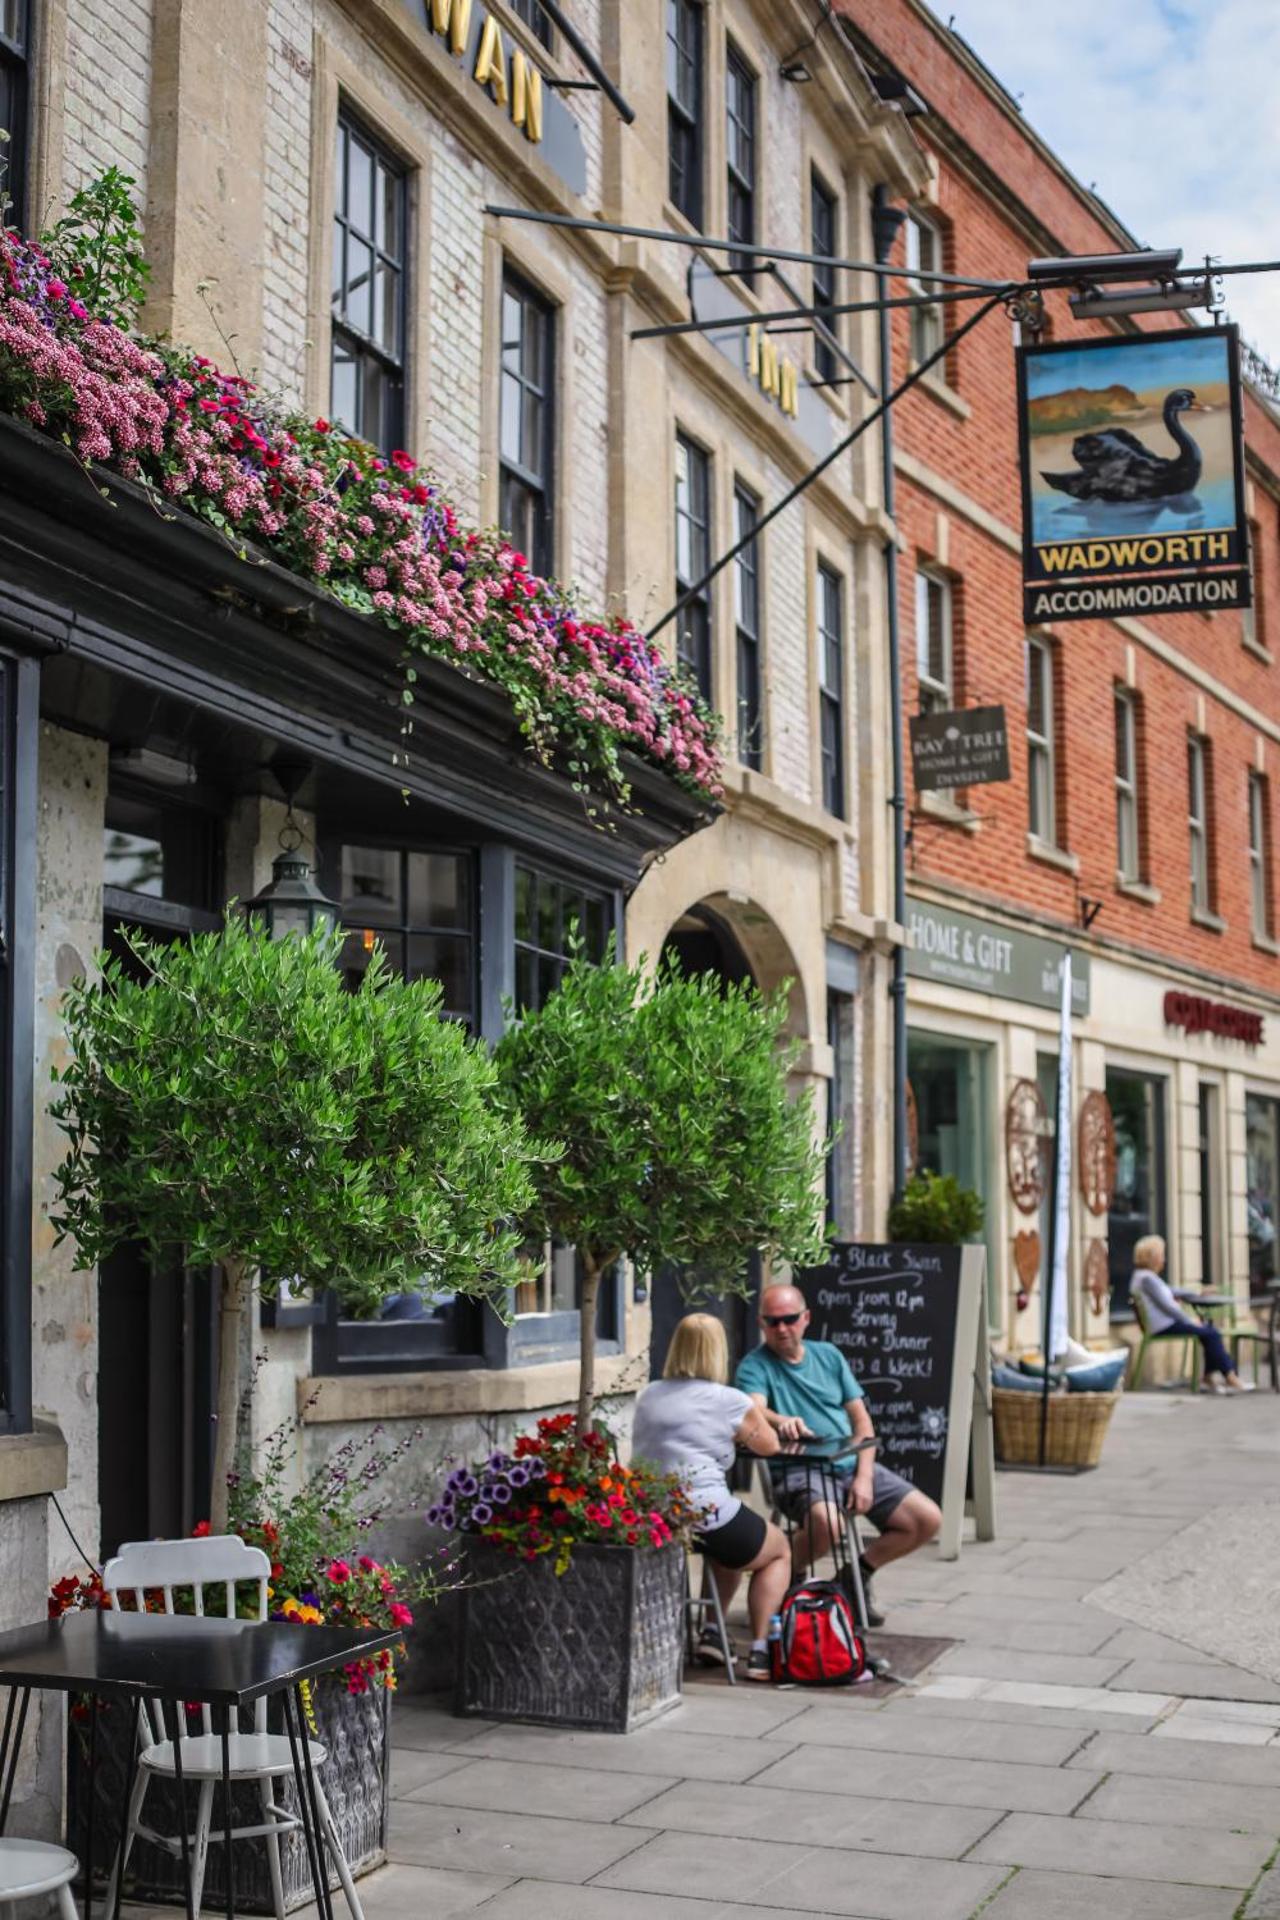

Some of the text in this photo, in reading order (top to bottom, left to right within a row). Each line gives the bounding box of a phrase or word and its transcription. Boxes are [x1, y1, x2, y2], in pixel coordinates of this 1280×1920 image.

[1039, 533, 1229, 572] WADWORTH
[1034, 579, 1237, 615] ACCOMMODATION
[913, 731, 1004, 755] BAY TREE
[910, 913, 959, 961] HOME
[962, 930, 976, 963] &
[977, 934, 1013, 974] GIFT
[848, 1246, 892, 1271] Black
[902, 1249, 942, 1272] Swan
[817, 1289, 851, 1309] Open
[857, 1290, 891, 1312] from
[851, 1307, 897, 1330] Serving
[881, 1328, 932, 1352] Dinner
